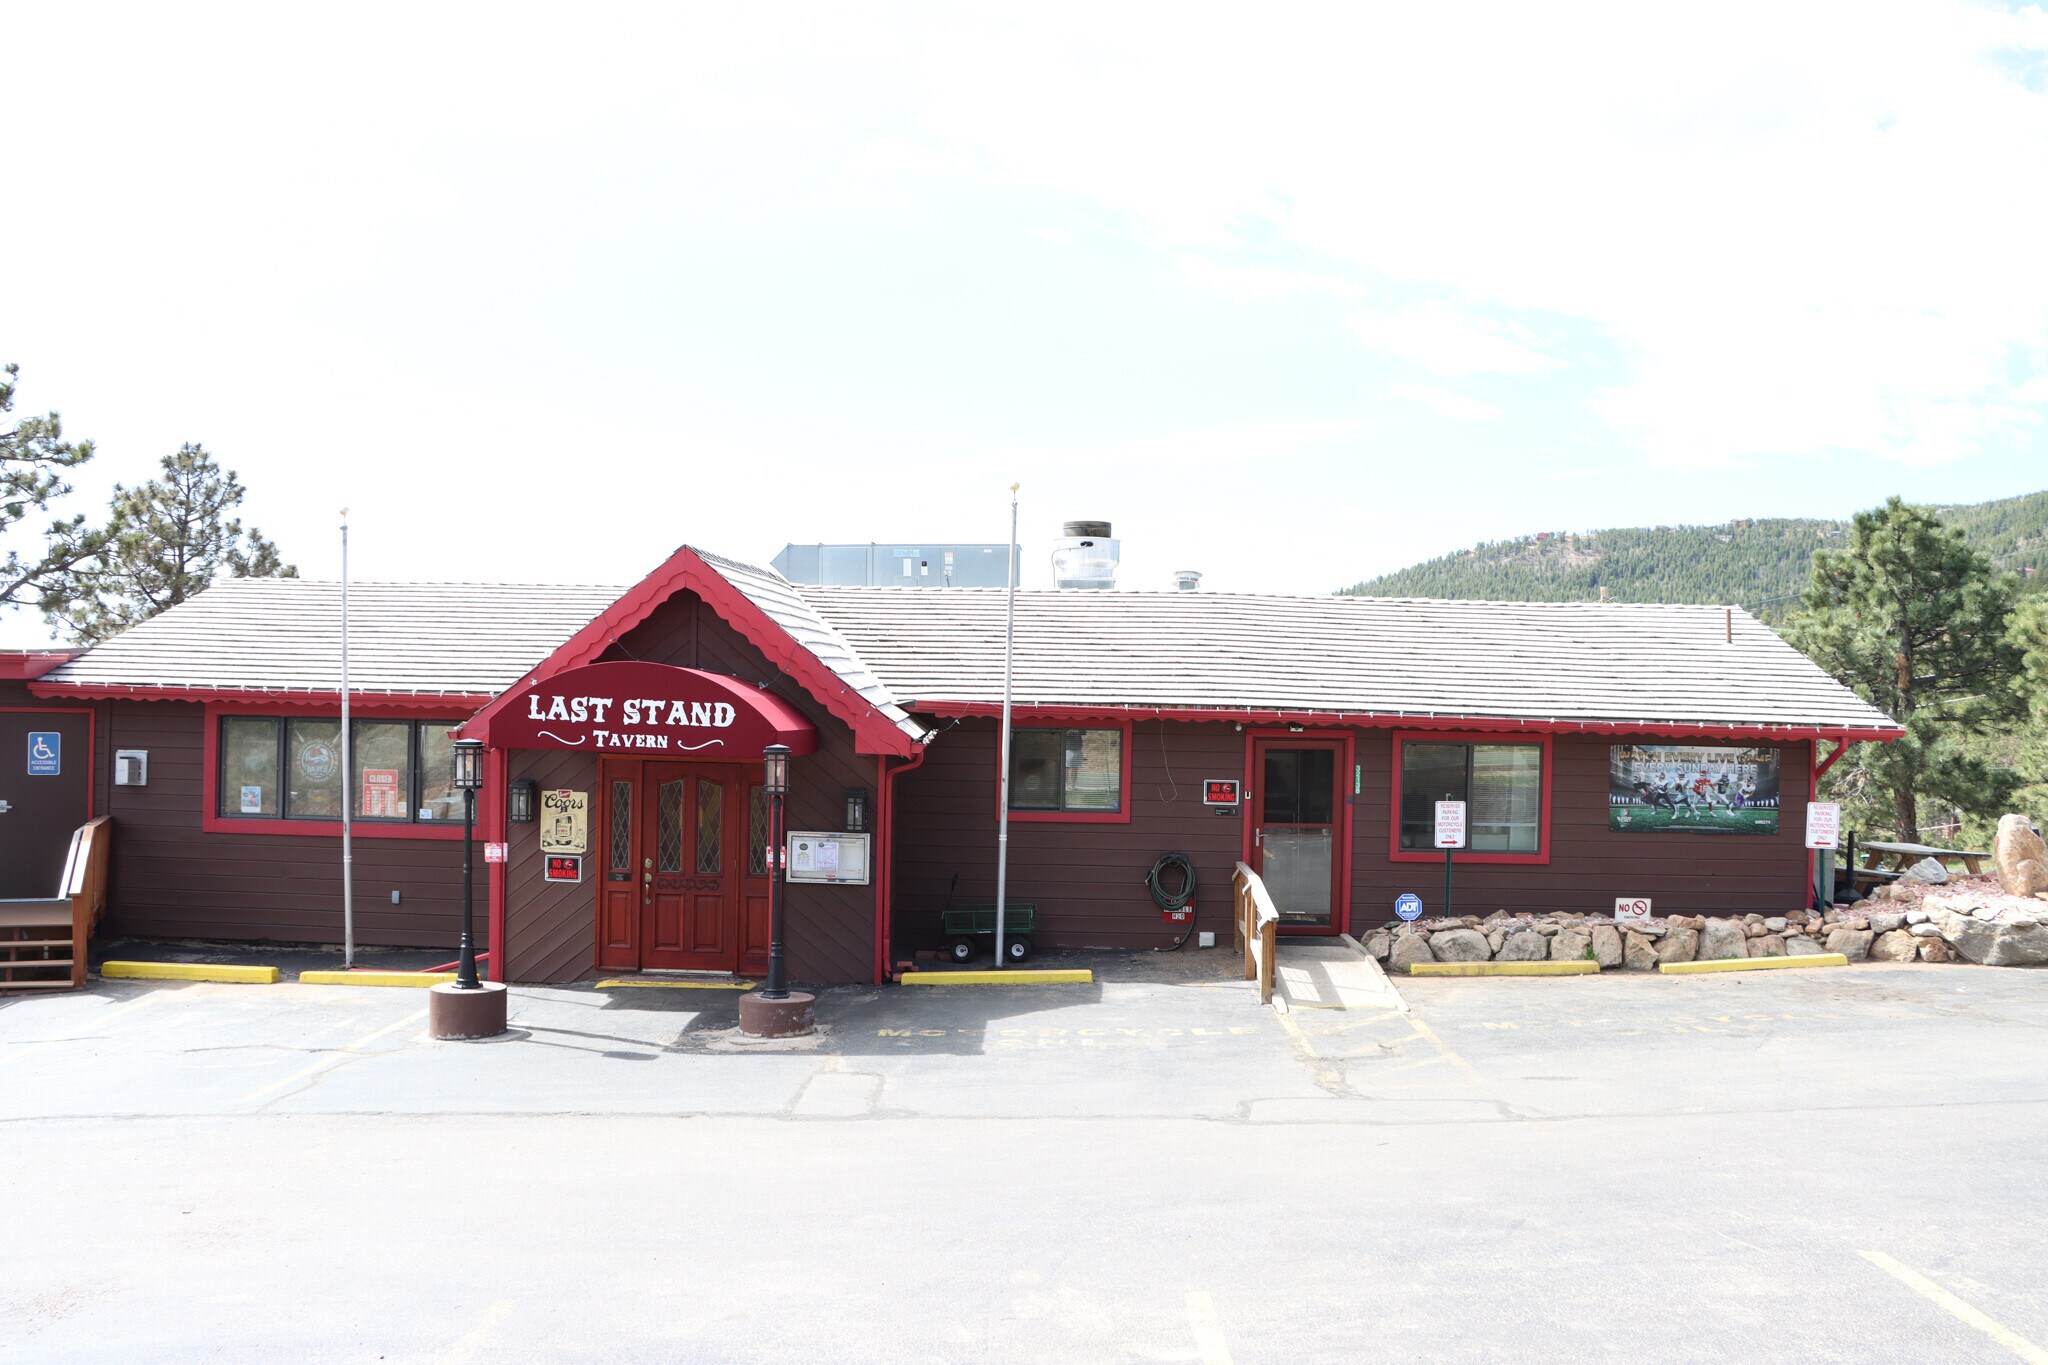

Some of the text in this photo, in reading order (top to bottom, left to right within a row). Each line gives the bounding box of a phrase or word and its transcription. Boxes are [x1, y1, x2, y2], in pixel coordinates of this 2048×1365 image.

[527, 694, 736, 727] LAST STAND
[592, 729, 668, 748] TAVERN
[1620, 750, 1772, 763] WATCH EVERY LIVE GAME
[1634, 762, 1758, 775] EVERY SUNDAY HERE
[369, 774, 393, 783] CLOSED
[1211, 783, 1220, 792] NO
[544, 793, 584, 810] Coors
[1207, 793, 1235, 801] SMOKING
[552, 859, 562, 868] NO
[548, 869, 578, 879] SMOKING
[1400, 902, 1418, 912] ADT
[1618, 904, 1630, 912] NO
